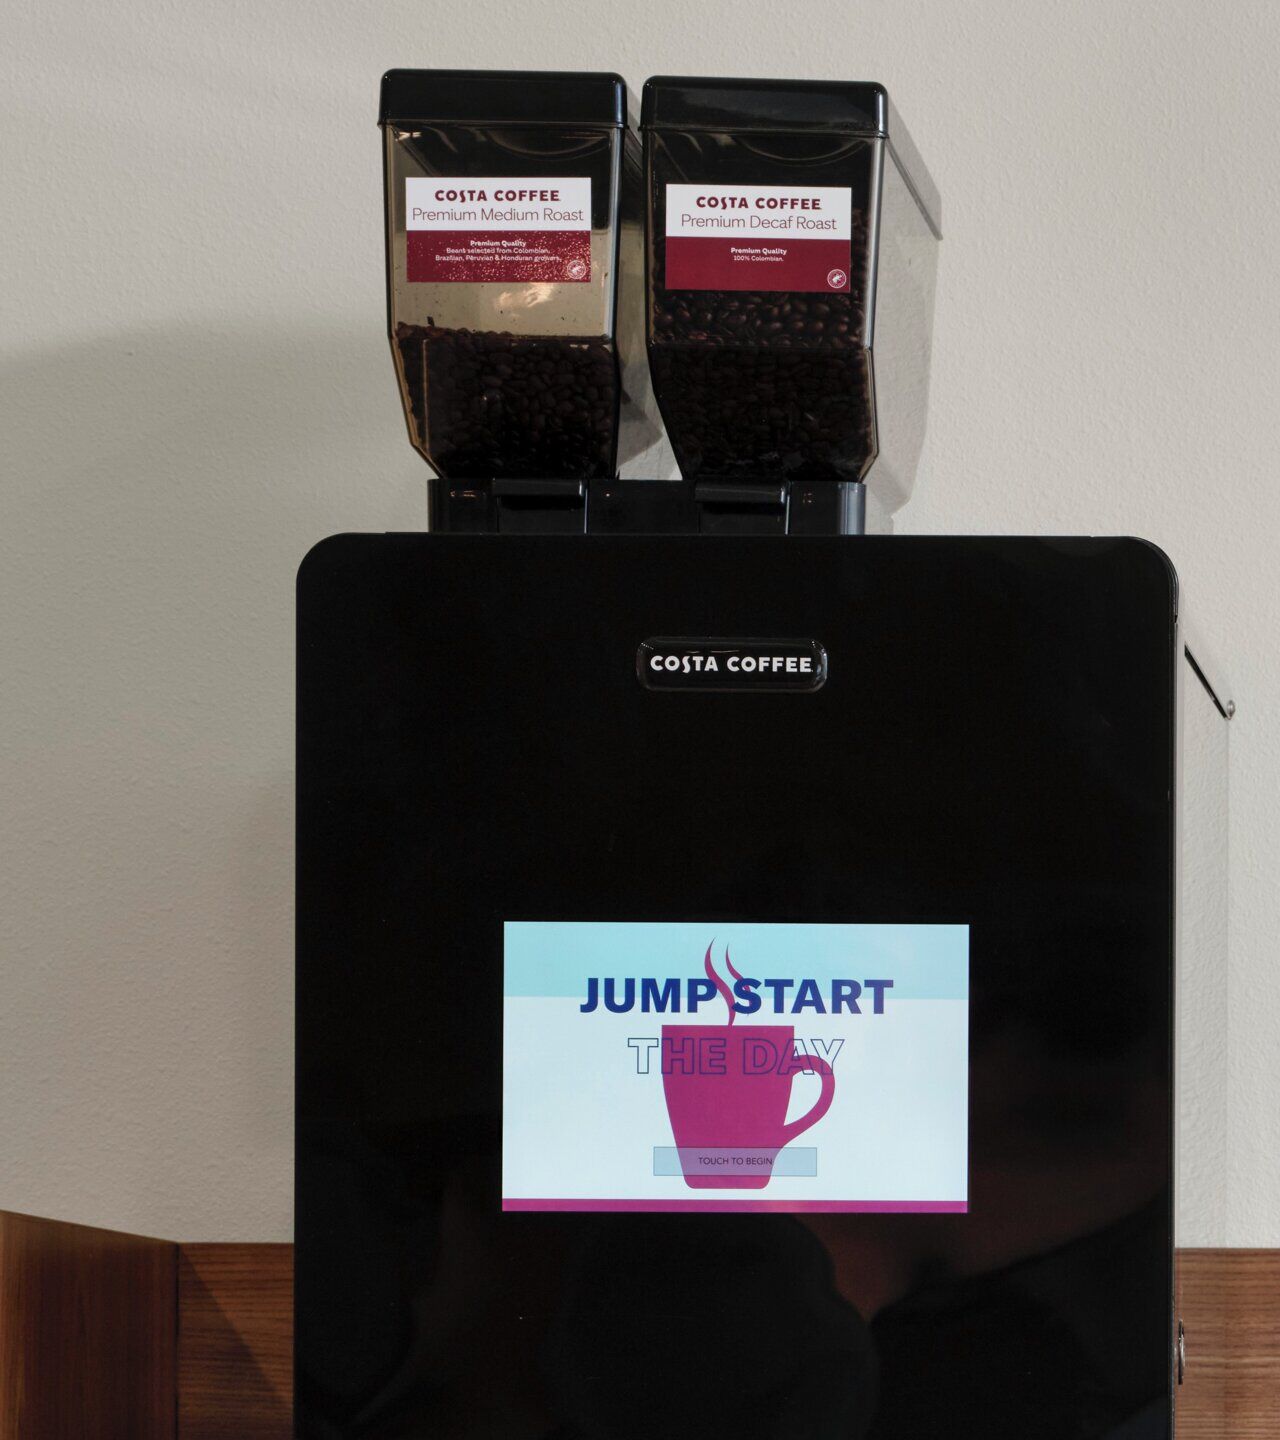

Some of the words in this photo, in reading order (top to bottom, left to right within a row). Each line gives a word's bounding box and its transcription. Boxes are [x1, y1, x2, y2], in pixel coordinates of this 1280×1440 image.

[434, 190, 487, 202] COSTA
[494, 190, 560, 202] COFFEE
[696, 197, 749, 210] COSTA
[755, 198, 821, 210] COFFEE
[412, 208, 476, 221] Premium
[481, 208, 538, 221] Medium
[543, 208, 584, 221] Roast
[681, 214, 746, 228] Premium
[750, 215, 794, 229] Decaf
[797, 216, 837, 230] Roast
[501, 240, 526, 248] Quality
[762, 248, 788, 256] Quality
[650, 655, 719, 674] COSTA
[726, 656, 812, 673] COFFEE
[579, 976, 718, 1014] JUMP
[730, 978, 894, 1015] START
[628, 1037, 728, 1075] THE
[742, 1038, 845, 1076] DAY
[698, 1157, 728, 1165] TOUCH
[732, 1157, 744, 1165] TO
[746, 1157, 773, 1166] BEGIN
